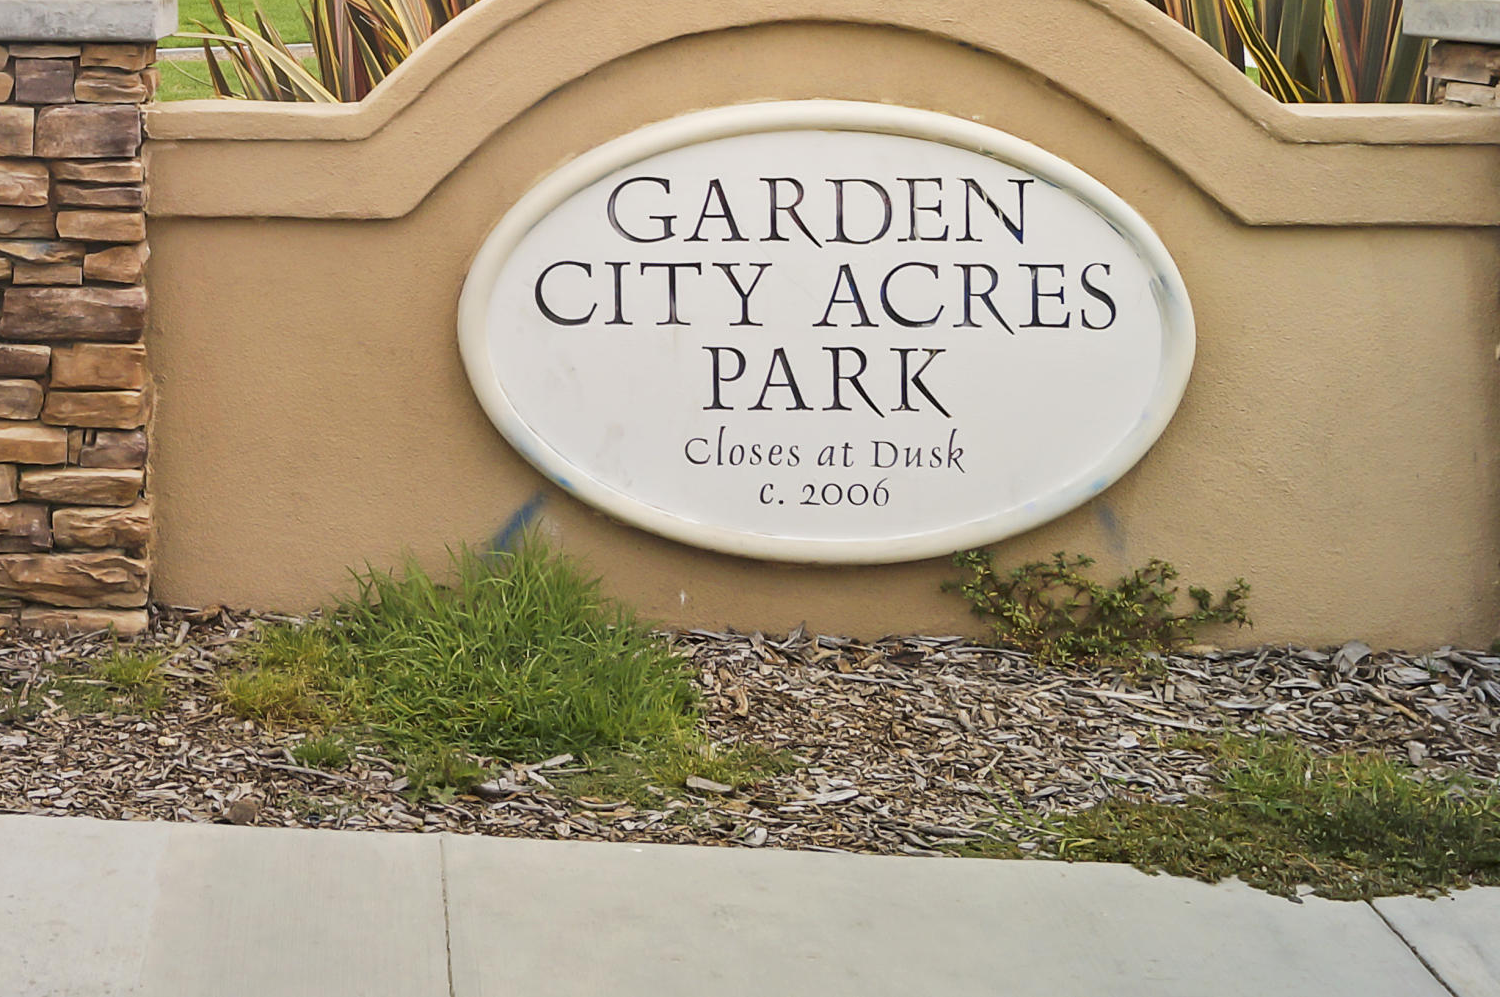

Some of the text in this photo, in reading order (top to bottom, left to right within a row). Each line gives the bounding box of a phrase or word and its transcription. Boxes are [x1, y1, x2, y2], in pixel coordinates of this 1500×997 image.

[606, 176, 1035, 248] GARDEN
[534, 260, 1117, 336] CITY ACRES
[701, 346, 952, 419] PARK
[684, 426, 966, 474] Closes at Dusk
[759, 479, 890, 506] c. 2006
